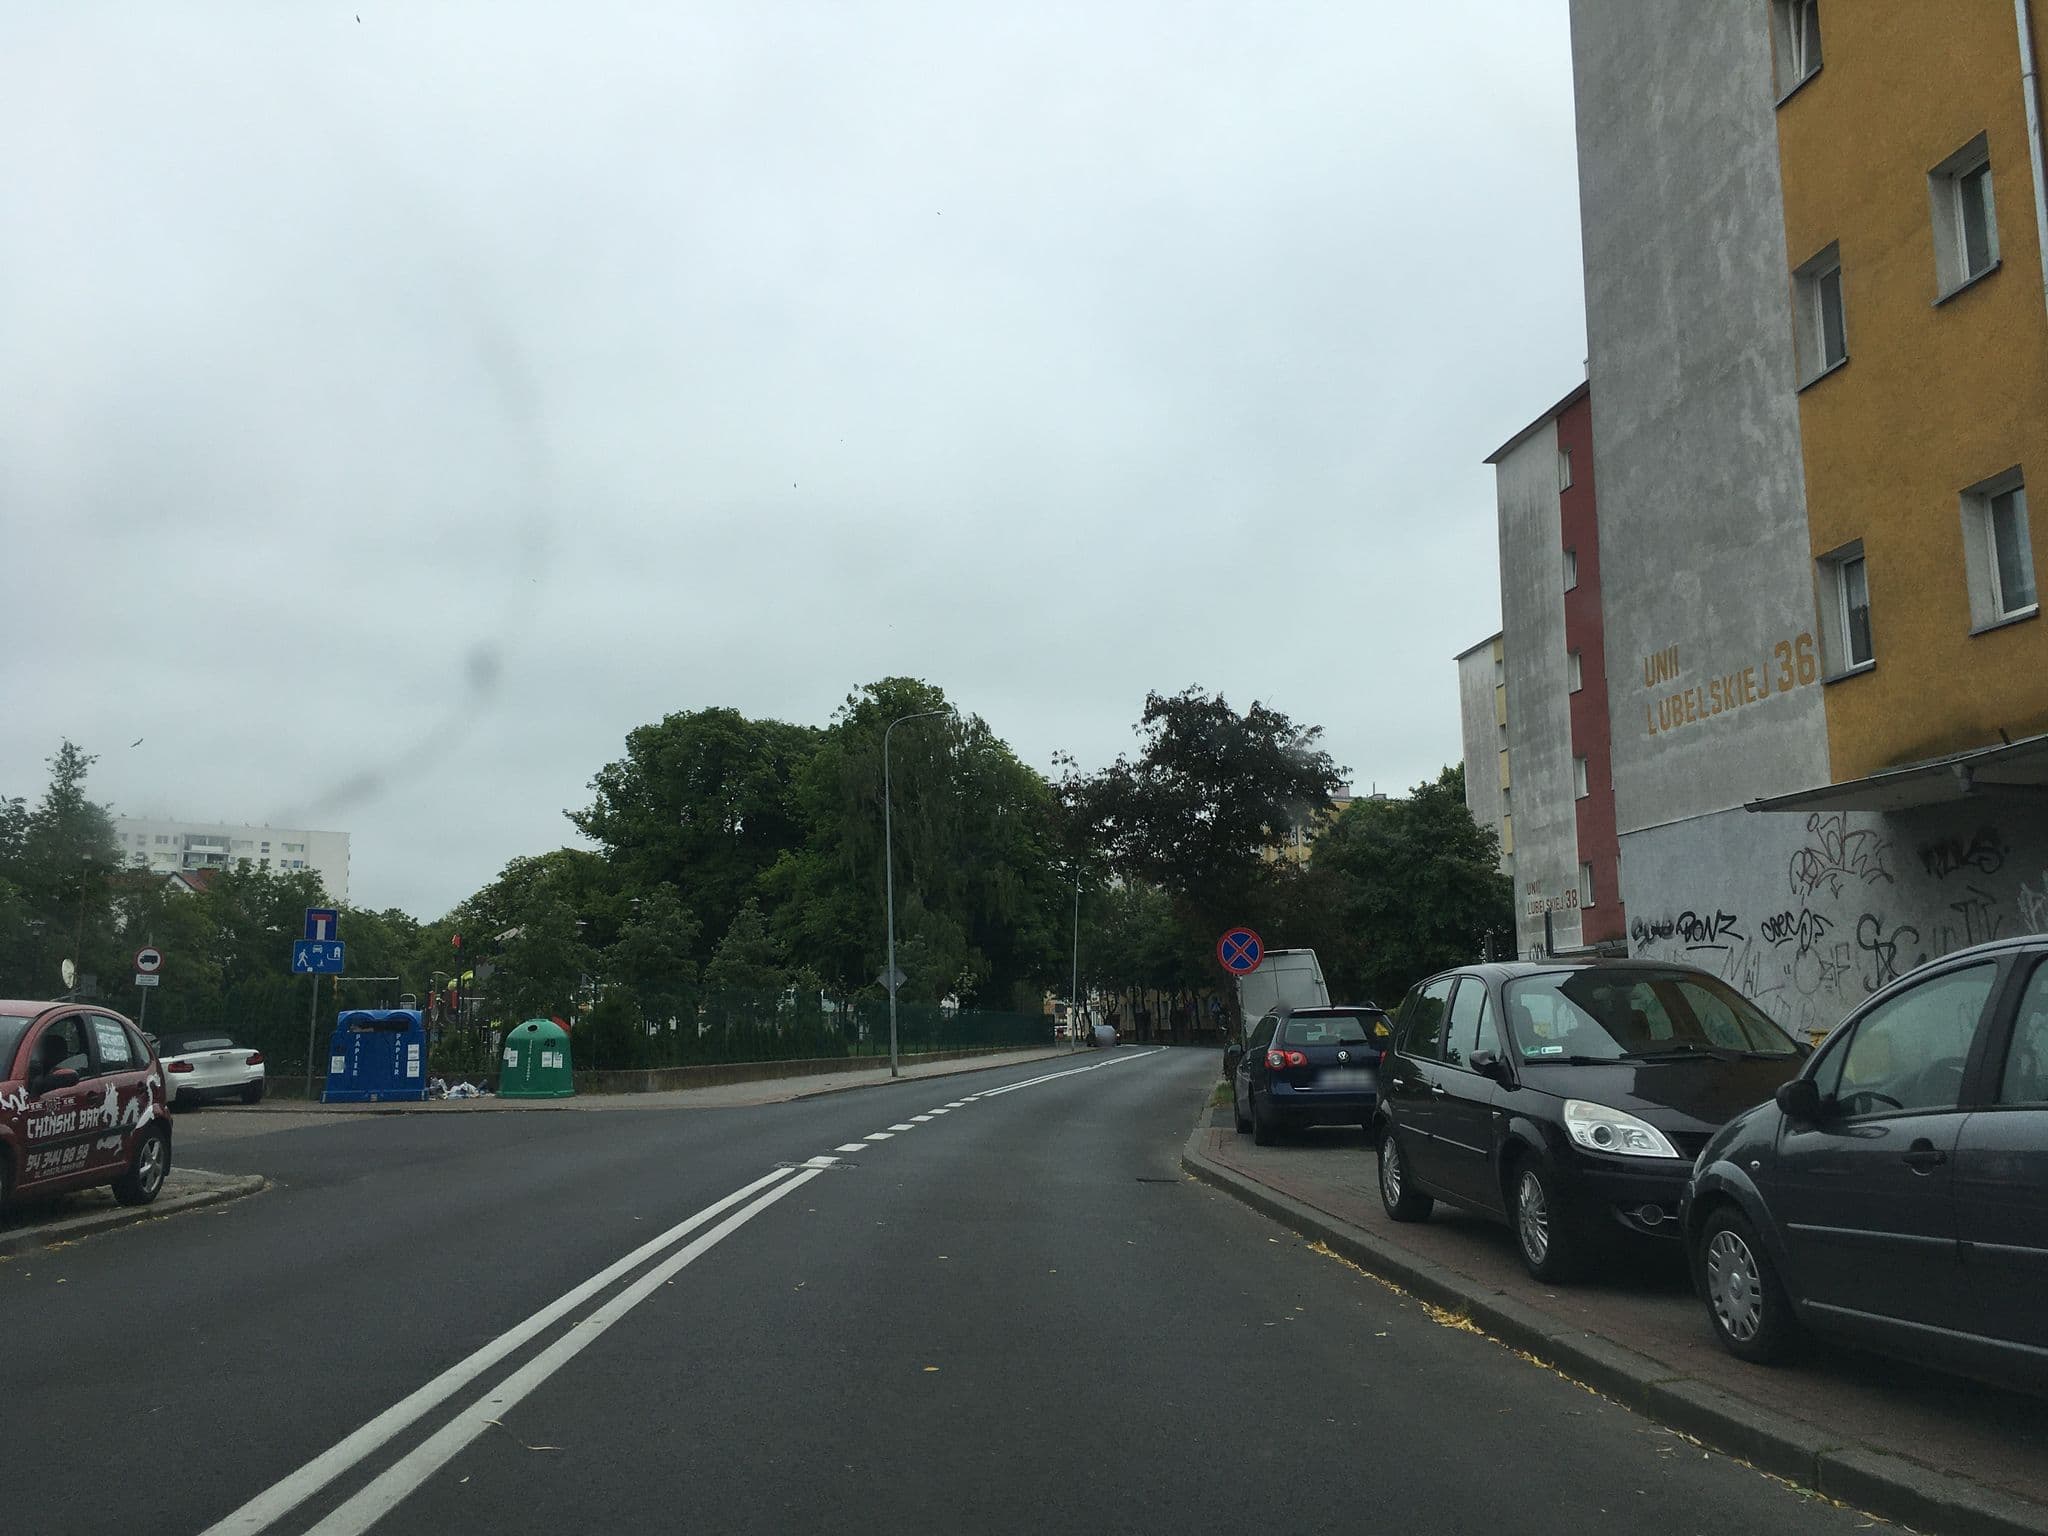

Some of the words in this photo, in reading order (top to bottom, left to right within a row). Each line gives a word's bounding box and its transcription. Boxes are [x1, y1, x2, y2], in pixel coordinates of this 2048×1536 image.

[1643, 643, 1680, 688] UNII
[1646, 661, 1771, 736] LUBELSKIEJ
[1774, 632, 1817, 693] 36
[1565, 889, 1578, 909] 38
[394, 1032, 402, 1076] PAPIER
[78, 1107, 100, 1130] BAR
